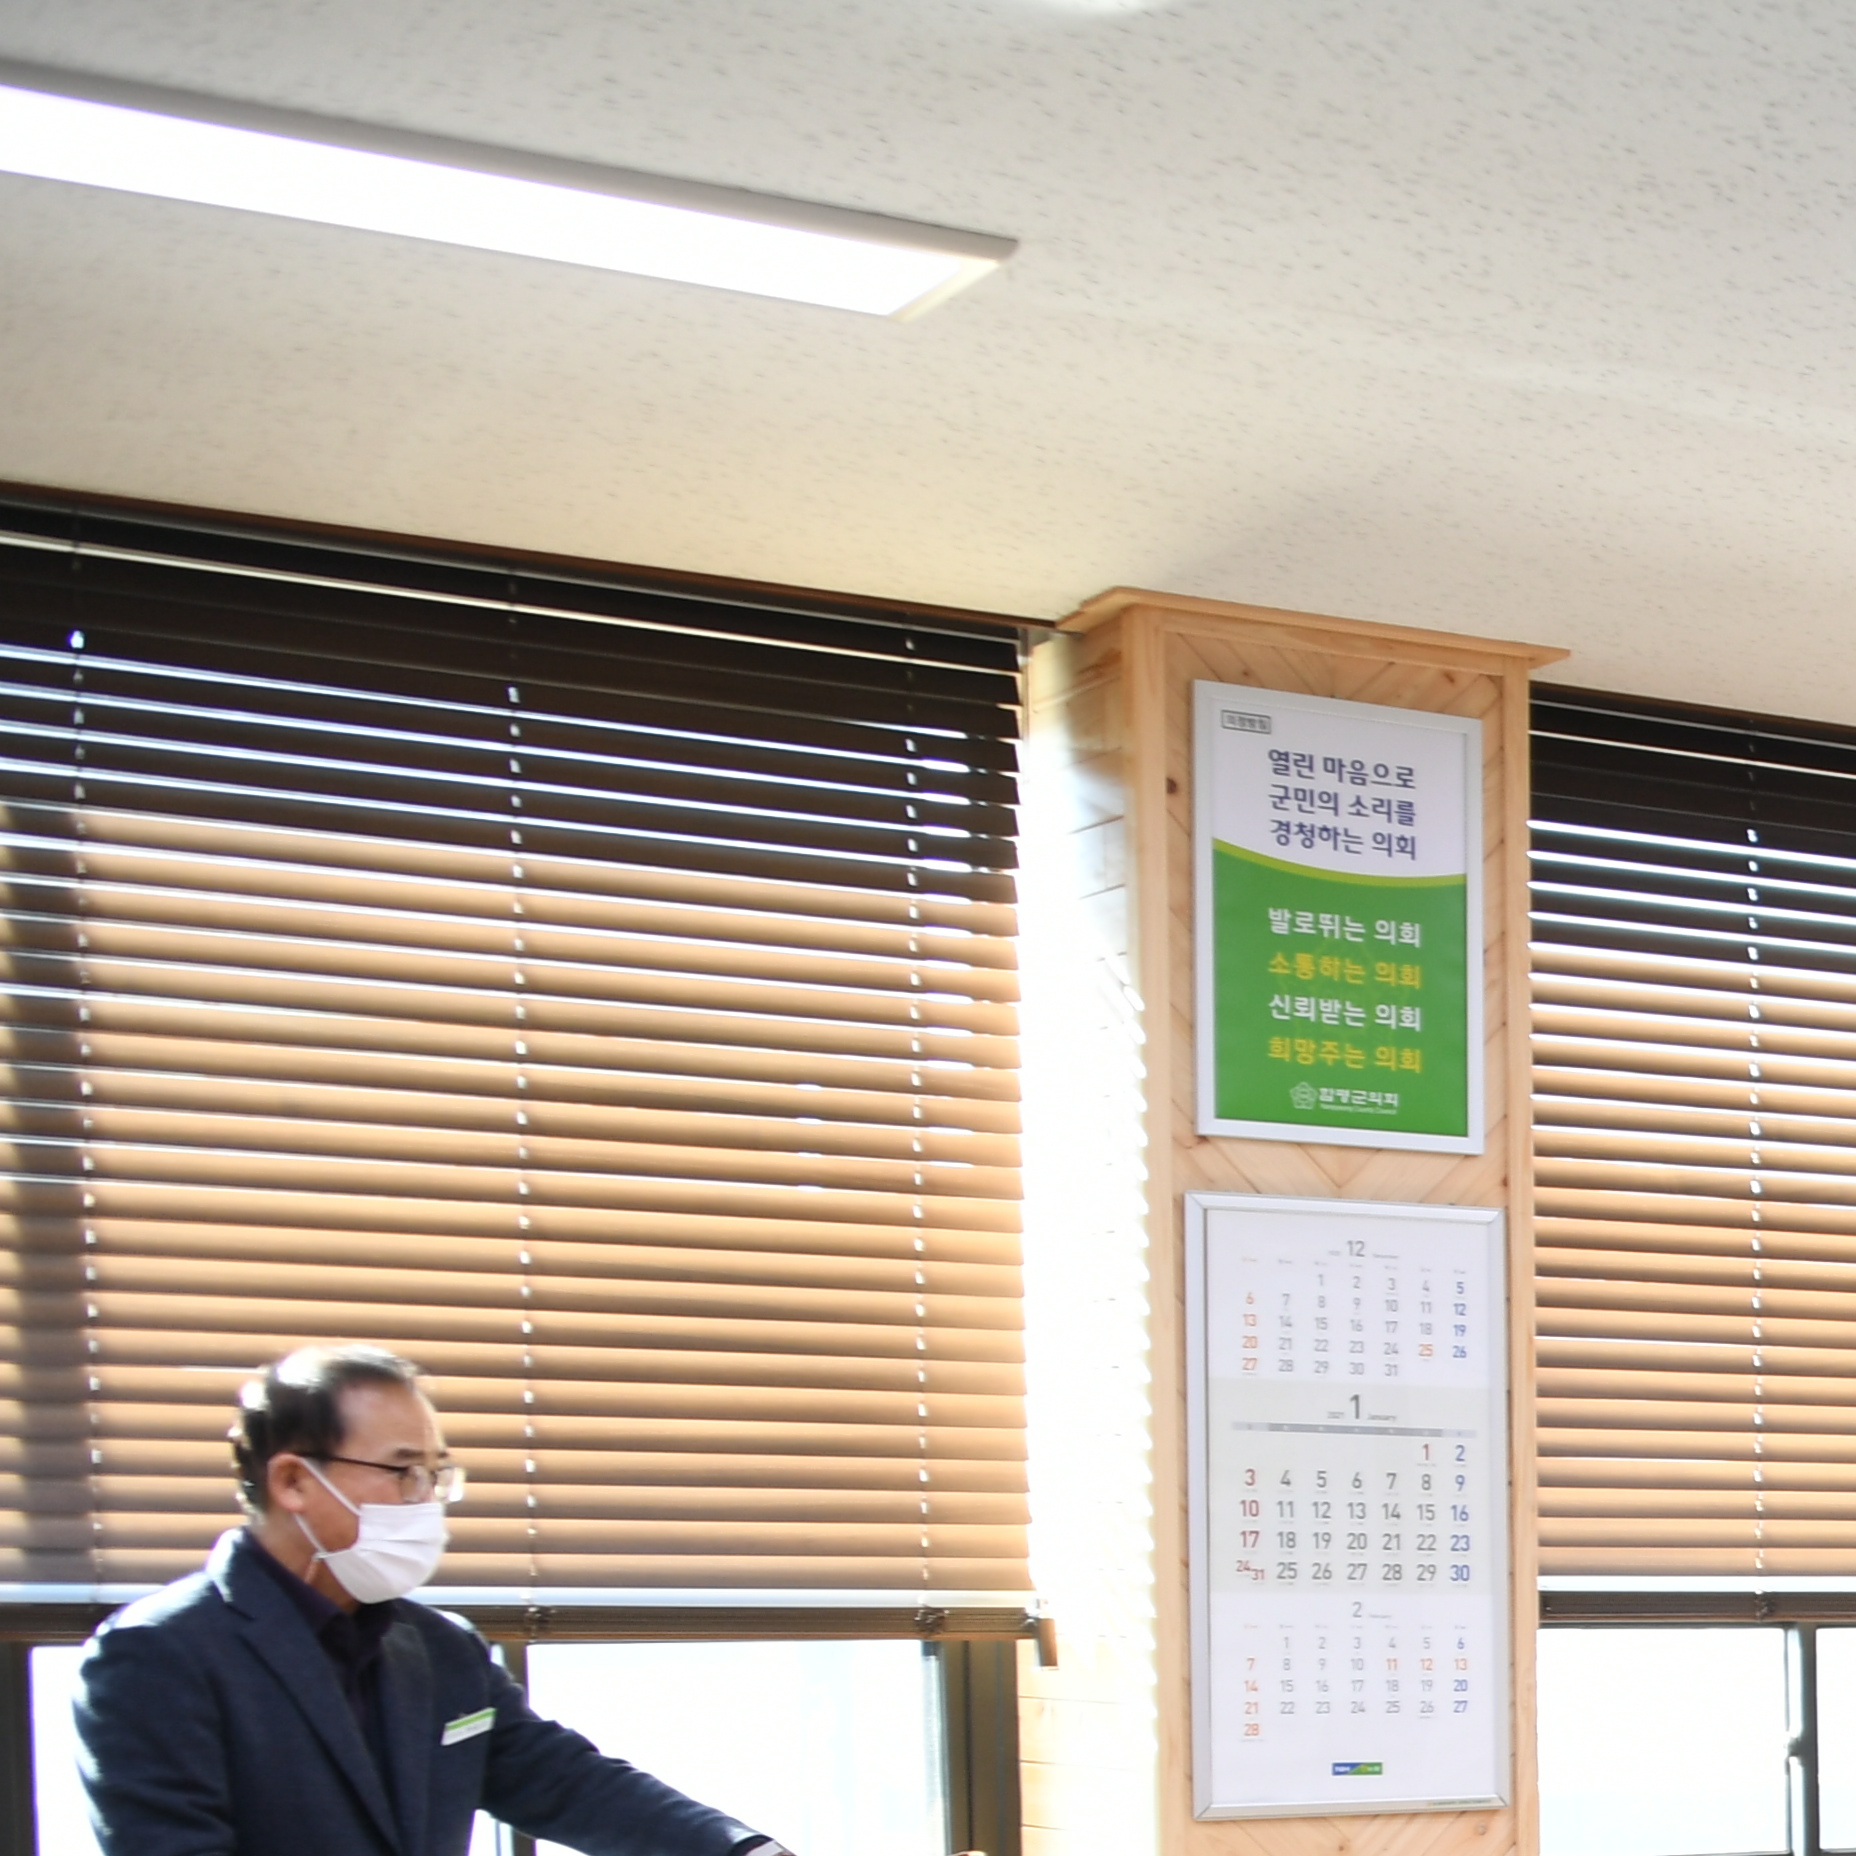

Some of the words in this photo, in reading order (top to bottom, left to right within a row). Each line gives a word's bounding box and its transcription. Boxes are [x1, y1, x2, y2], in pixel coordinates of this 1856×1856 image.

[1268, 749, 1314, 779] 열린
[1322, 756, 1416, 789] 마음으로
[1268, 785, 1340, 817] 군민의
[1347, 794, 1417, 826] 소리를
[1270, 820, 1364, 855] 경청하는
[1372, 833, 1417, 861] 의회
[1268, 908, 1366, 942] 발로뛰는
[1375, 921, 1421, 947] 의회
[1268, 952, 1366, 985] 소통하는
[1375, 963, 1421, 989] 의회
[1268, 994, 1366, 1028] 신뢰받는
[1375, 1005, 1421, 1031] 의회
[1268, 1037, 1366, 1070] 희망주는
[1375, 1047, 1421, 1074] 의회
[1347, 1240, 1365, 1257] 12
[1317, 1274, 1325, 1286] 1
[1352, 1276, 1361, 1289] 2
[1387, 1278, 1396, 1290] 3
[1421, 1280, 1431, 1292] 4
[1456, 1282, 1465, 1294] 5
[1245, 1292, 1255, 1304] 6
[1281, 1293, 1291, 1306] 7
[1317, 1295, 1327, 1308] 8
[1352, 1297, 1362, 1310] 9
[1385, 1299, 1398, 1312] 10
[1420, 1301, 1432, 1314] 11
[1454, 1303, 1466, 1316] 12
[1243, 1314, 1257, 1327] 13
[1279, 1316, 1293, 1327] 14
[1315, 1317, 1328, 1330] 15
[1350, 1319, 1363, 1332] 16
[1385, 1321, 1398, 1333] 17
[1419, 1322, 1432, 1335] 18
[1453, 1324, 1466, 1336] 19
[1242, 1336, 1258, 1349] 20
[1279, 1337, 1292, 1350] 21
[1314, 1339, 1329, 1352] 22
[1349, 1340, 1364, 1353] 23
[1384, 1342, 1399, 1355] 24
[1418, 1344, 1433, 1357] 25
[1453, 1345, 1467, 1358] 26
[1242, 1358, 1258, 1370] 27
[1278, 1359, 1294, 1372] 28
[1314, 1360, 1329, 1373] 29
[1349, 1362, 1365, 1375] 30
[1385, 1363, 1398, 1376] 31
[1350, 1394, 1360, 1419] 1
[1422, 1444, 1430, 1460] 1
[1455, 1445, 1465, 1461] 2
[1245, 1469, 1255, 1486] 3
[1280, 1470, 1291, 1486] 4
[1317, 1471, 1327, 1488] 5
[1352, 1472, 1362, 1489] 6
[1386, 1473, 1397, 1489] 7
[1422, 1474, 1431, 1490] 8
[1455, 1475, 1465, 1491] 9
[1240, 1500, 1259, 1517] 10
[1277, 1501, 1294, 1518] 11
[1312, 1501, 1331, 1519] 12
[1347, 1502, 1366, 1519] 13
[1382, 1503, 1401, 1519] 14
[1417, 1504, 1435, 1521] 15
[1451, 1505, 1469, 1521] 16
[1240, 1530, 1260, 1548] 17
[1277, 1531, 1296, 1548] 18
[1313, 1532, 1331, 1549] 19
[1347, 1533, 1367, 1550] 20
[1382, 1533, 1400, 1550] 21
[1416, 1534, 1436, 1551] 22
[1450, 1535, 1470, 1551] 23
[1236, 1560, 1251, 1572] 24
[1250, 1568, 1265, 1580] 31
[1277, 1562, 1297, 1579] 25
[1312, 1563, 1332, 1580] 26
[1347, 1563, 1367, 1580] 27
[1382, 1564, 1402, 1580] 28
[1417, 1564, 1436, 1581] 29
[1450, 1565, 1470, 1581] 30
[1352, 1602, 1362, 1618] 2
[1282, 1637, 1290, 1649] 1
[1317, 1637, 1327, 1649] 2
[1353, 1637, 1362, 1649] 3
[1388, 1637, 1397, 1648] 4
[1422, 1637, 1431, 1649] 5
[1456, 1638, 1465, 1649] 6
[1246, 1658, 1256, 1670] 7
[1282, 1658, 1291, 1671] 8
[1317, 1658, 1327, 1670] 9
[1351, 1658, 1364, 1671] 10
[1386, 1658, 1398, 1671] 11
[1420, 1658, 1433, 1671] 12
[1454, 1658, 1468, 1671] 13
[1244, 1680, 1258, 1692] 14
[1280, 1680, 1294, 1692] 15
[1316, 1680, 1329, 1692] 16
[1352, 1679, 1364, 1692] 17
[1386, 1679, 1399, 1692] 18
[1421, 1679, 1433, 1691] 19
[1454, 1679, 1468, 1692] 20
[1244, 1702, 1258, 1715] 21
[1280, 1701, 1295, 1714] 22
[1316, 1701, 1331, 1714] 23
[1351, 1701, 1366, 1714] 24
[1386, 1701, 1400, 1713] 25
[1420, 1701, 1434, 1713] 26
[1453, 1700, 1468, 1713] 27
[1244, 1723, 1260, 1736] 28
